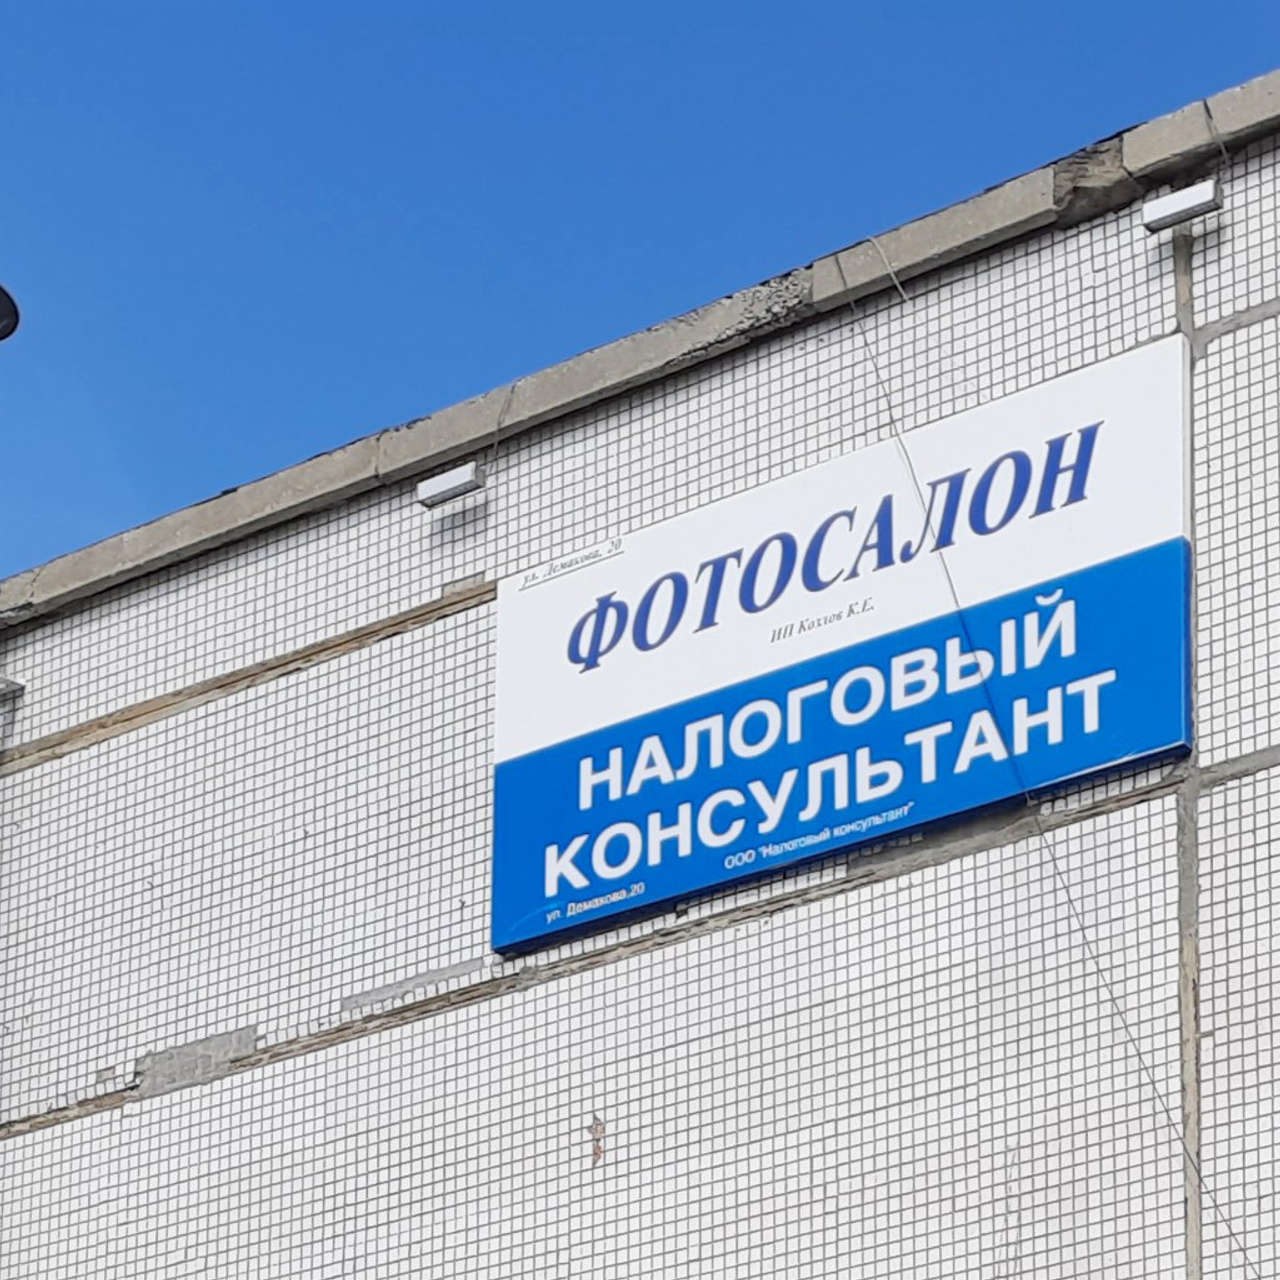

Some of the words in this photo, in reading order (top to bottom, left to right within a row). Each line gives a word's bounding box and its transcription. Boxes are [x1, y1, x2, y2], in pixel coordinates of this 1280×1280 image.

[567, 421, 1105, 674] ФОТОСАЛОН
[770, 623, 794, 644] ИП
[797, 611, 844, 634] Козлов
[544, 669, 1117, 898] КОНСУЛЬТАНТ
[579, 588, 1078, 812] НАЛОГОВЫЙ
[724, 850, 757, 870] ООО
